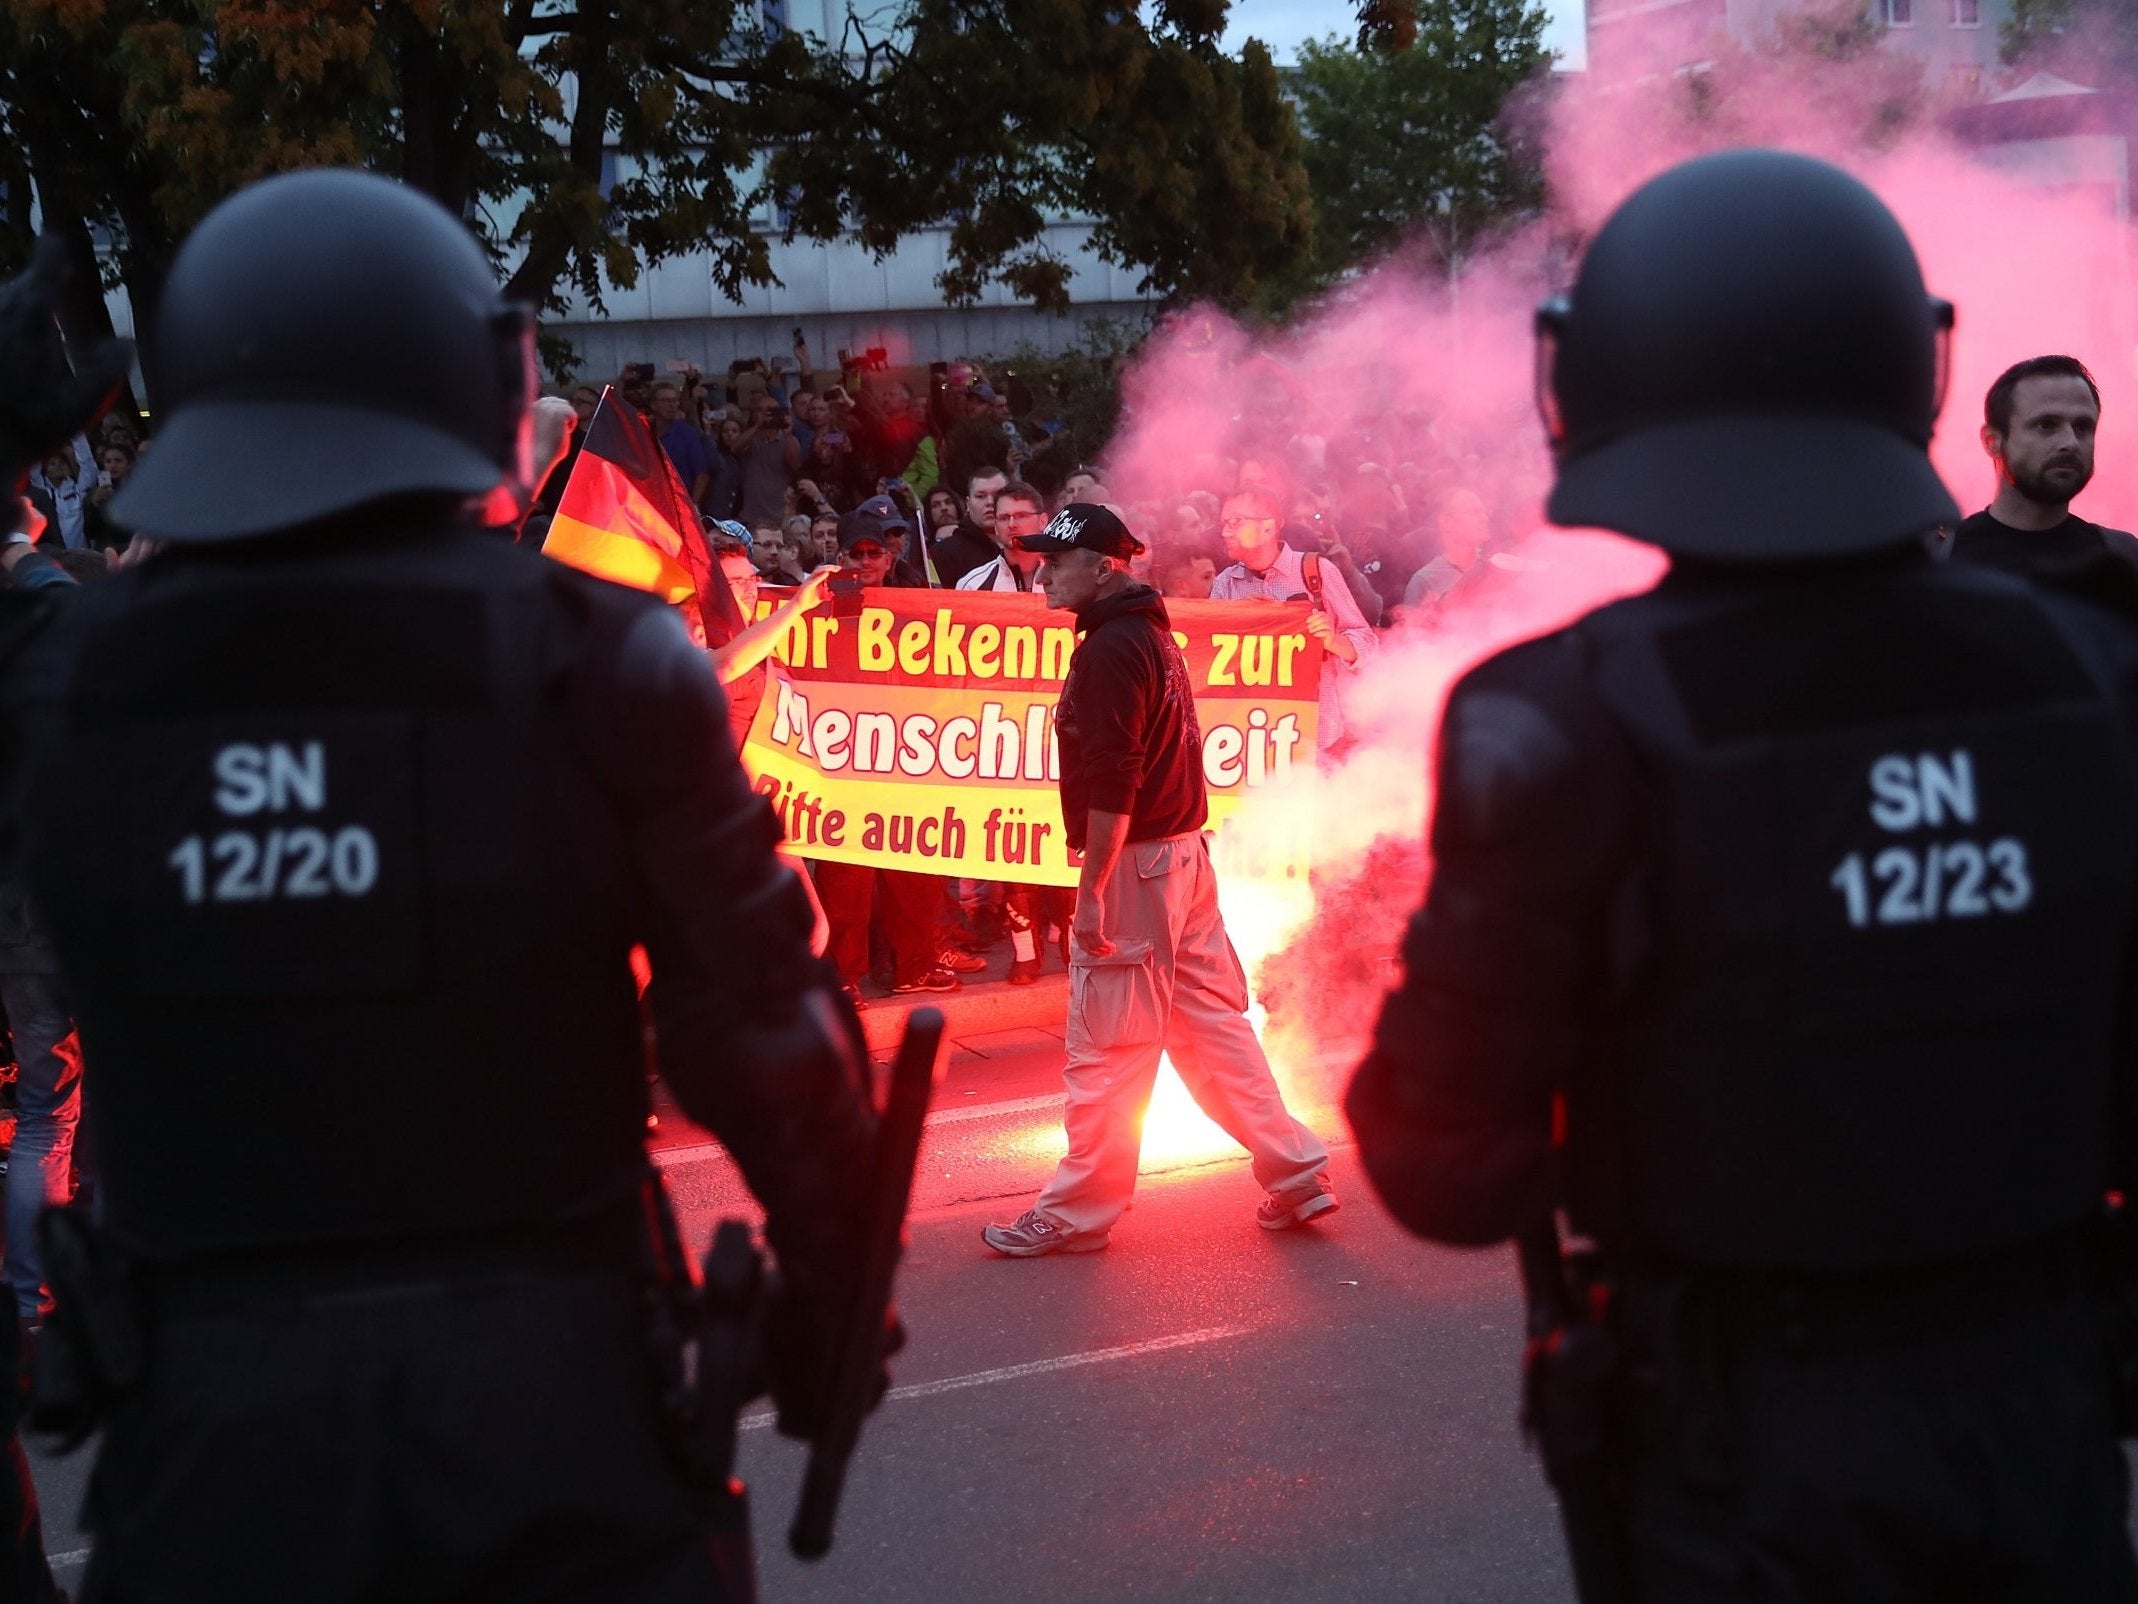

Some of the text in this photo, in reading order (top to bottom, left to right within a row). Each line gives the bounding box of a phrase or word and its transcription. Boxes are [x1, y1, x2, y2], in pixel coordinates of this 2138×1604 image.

[857, 607, 1189, 680] Bekenn
[1206, 632, 1307, 687] zur
[771, 678, 1300, 790] Menschlieit
[213, 739, 326, 816] SN
[1869, 747, 1978, 833] SN
[167, 824, 379, 904] 12/20
[861, 806, 966, 859] auch
[983, 807, 1051, 866] für
[1829, 836, 2034, 928] 12/23
